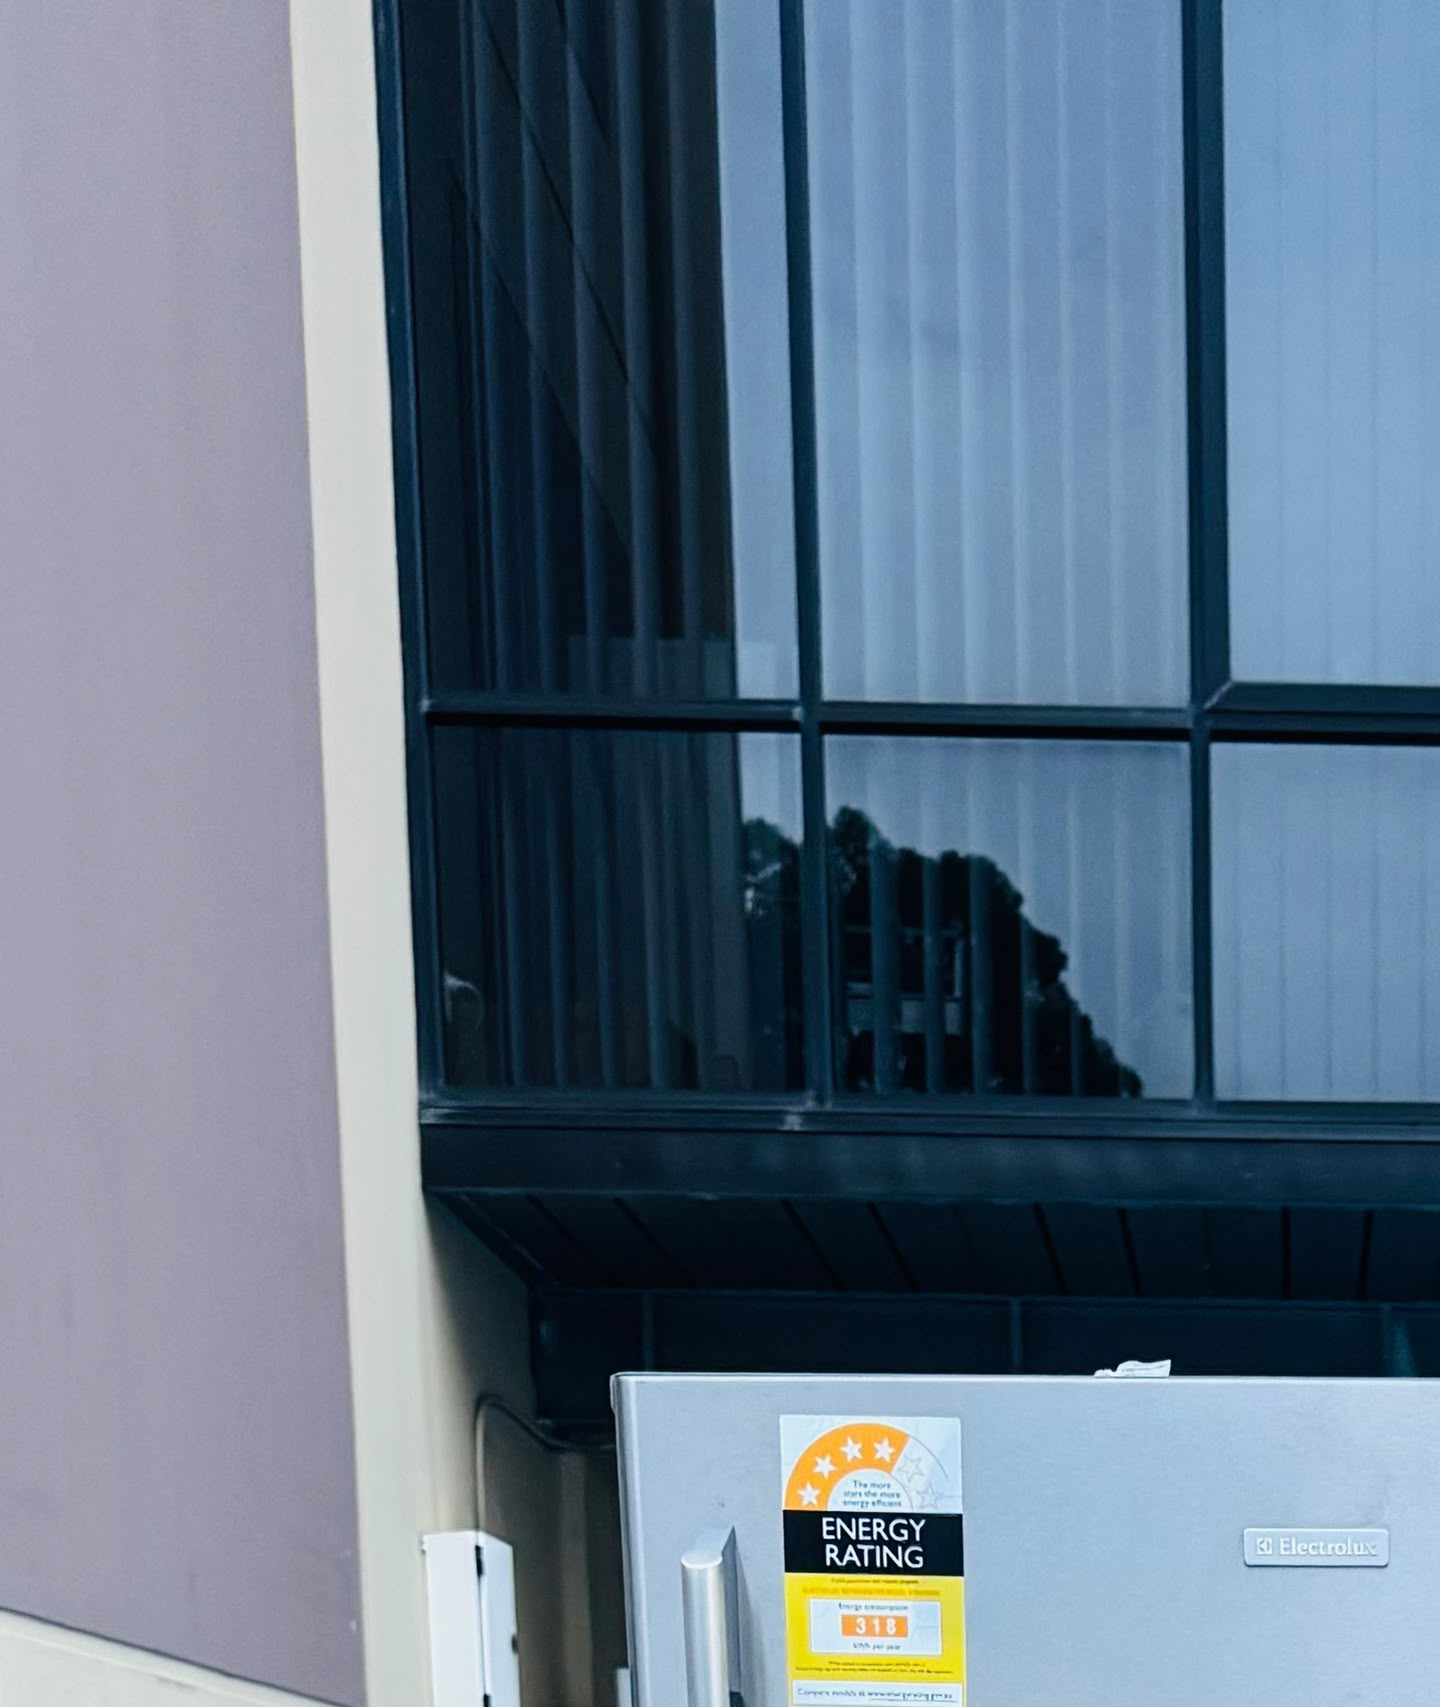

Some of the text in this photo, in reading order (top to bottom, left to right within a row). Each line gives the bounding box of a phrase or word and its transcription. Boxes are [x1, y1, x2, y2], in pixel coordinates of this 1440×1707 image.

[853, 1480, 868, 1489] The
[821, 1516, 926, 1542] ENERGY
[825, 1543, 924, 1568] RATING
[1279, 1536, 1378, 1556] Electrolux
[855, 1616, 897, 1636] 318
